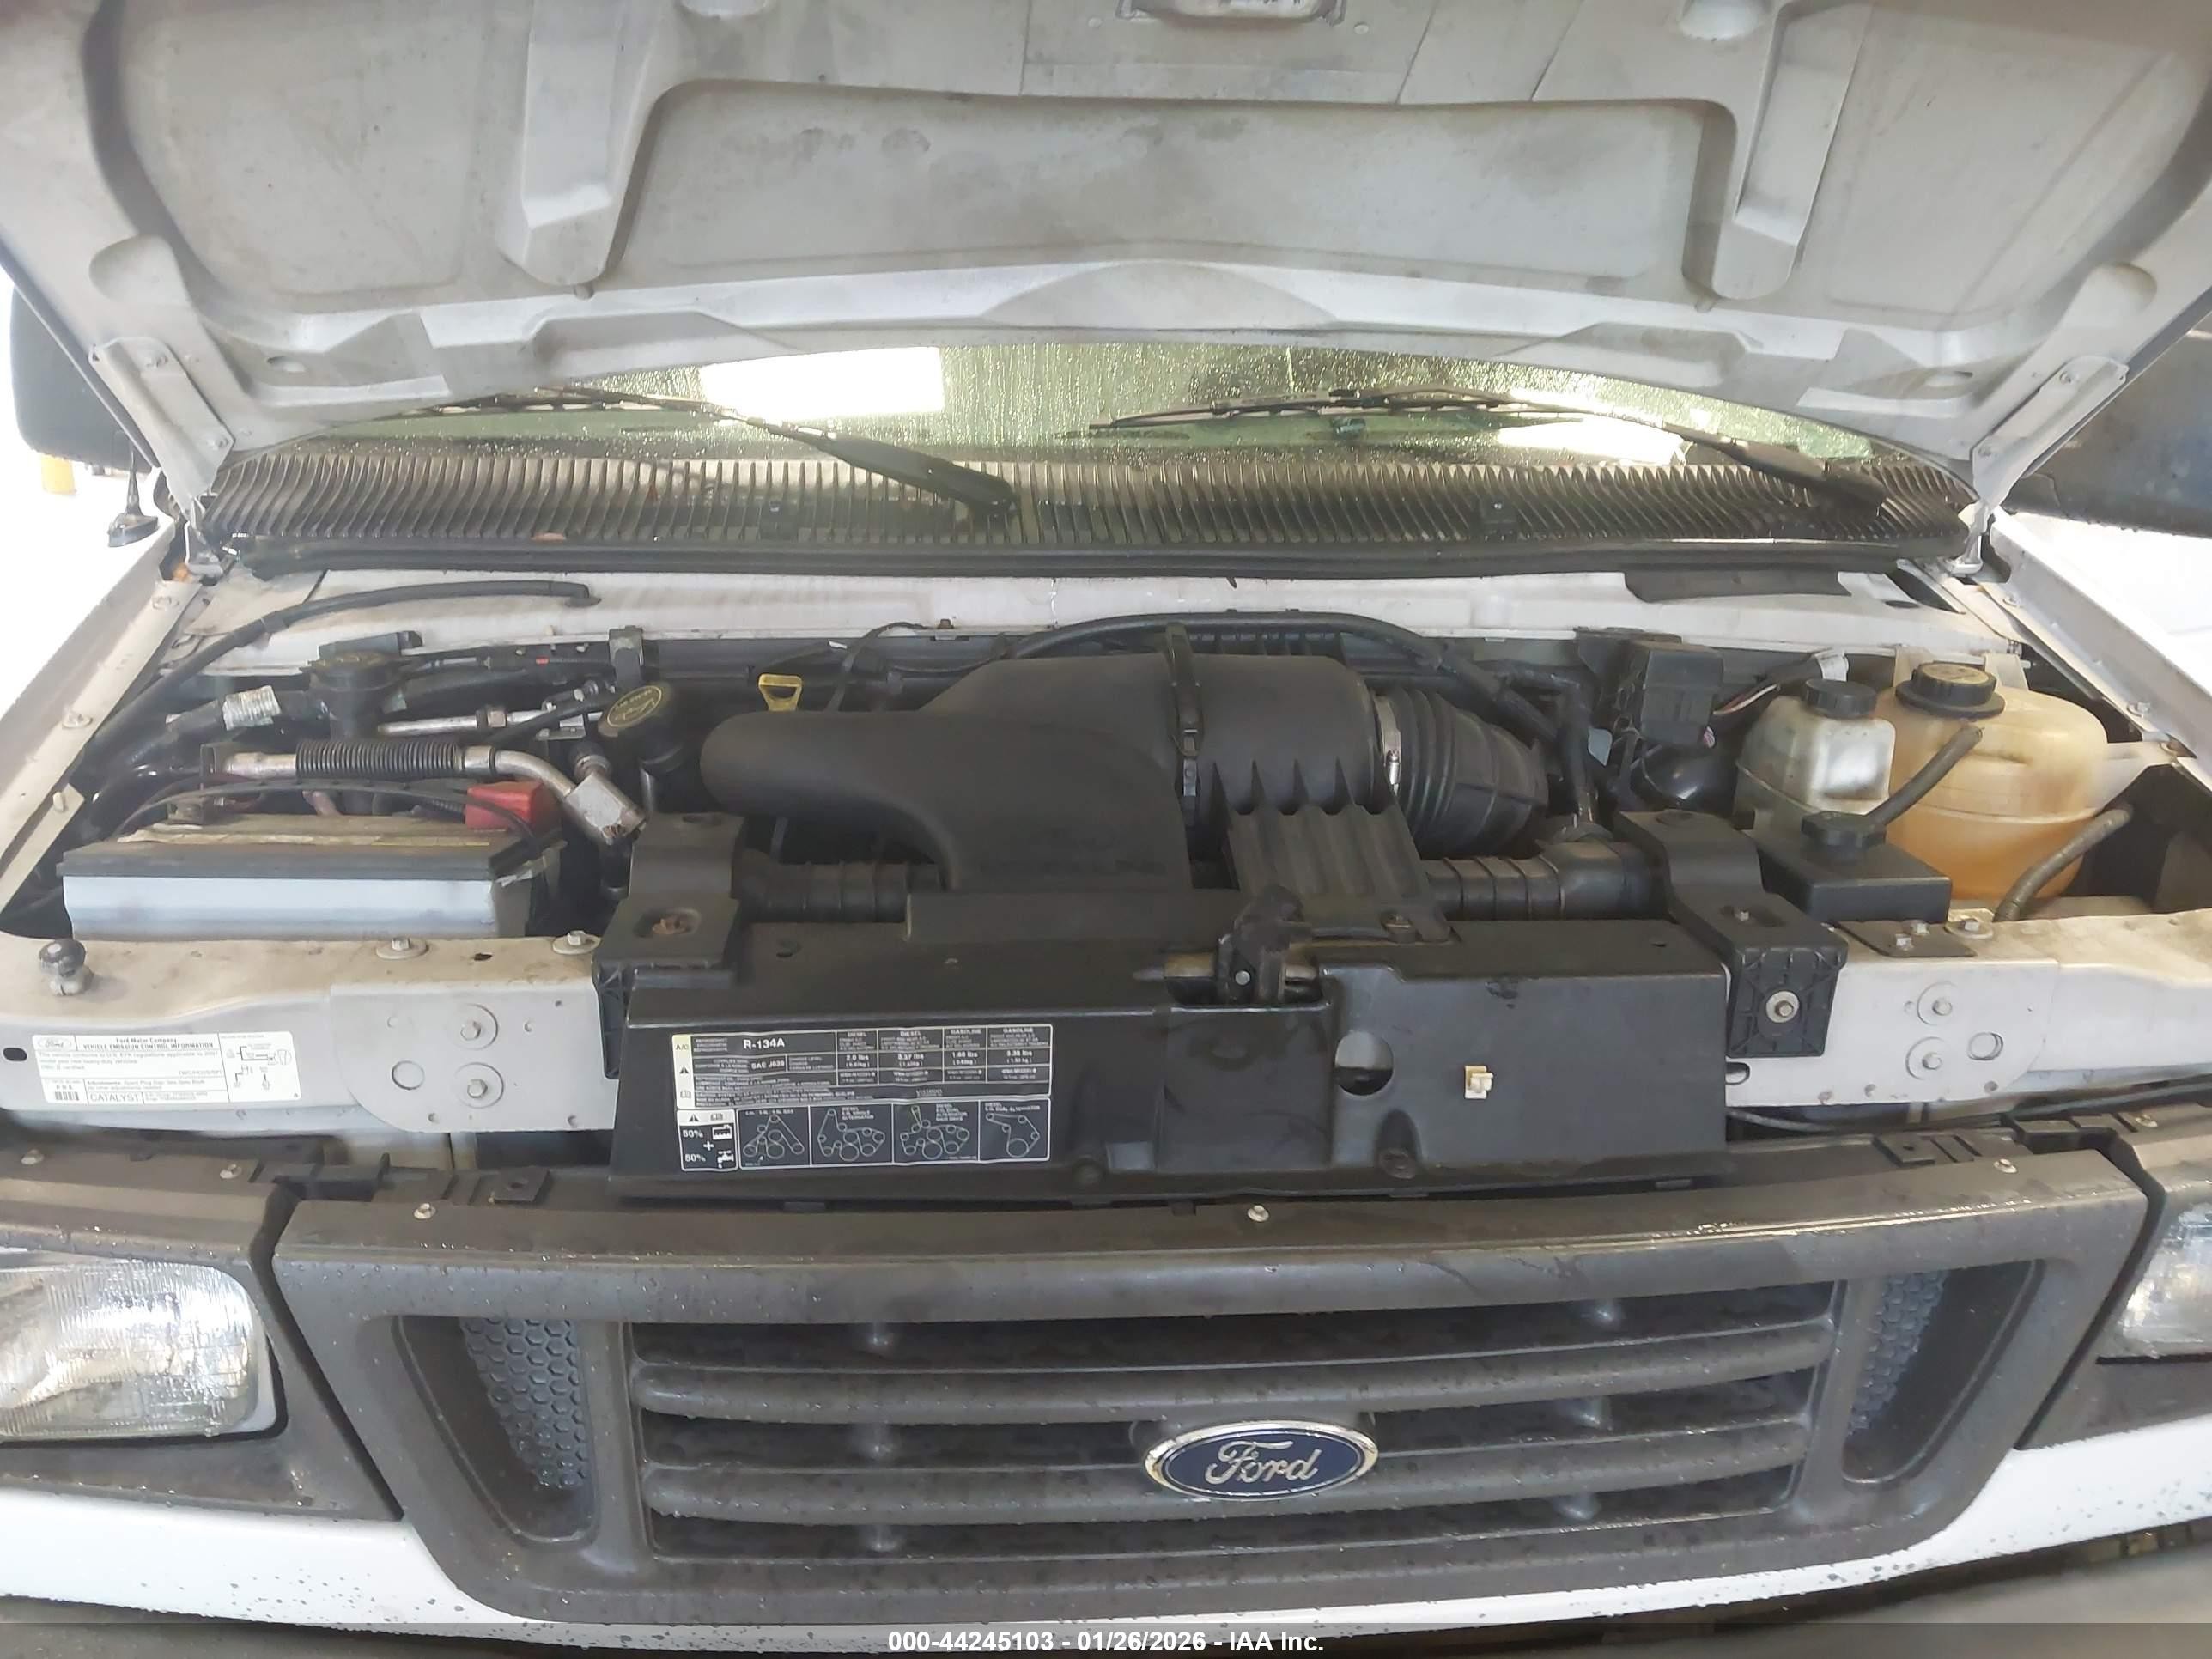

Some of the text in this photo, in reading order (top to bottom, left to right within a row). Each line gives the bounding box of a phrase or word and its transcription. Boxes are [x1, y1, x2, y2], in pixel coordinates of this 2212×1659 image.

[743, 1037, 786, 1050] R-134A
[90, 1093, 138, 1102] CATALYST
[1205, 1441, 1322, 1485] Ford
